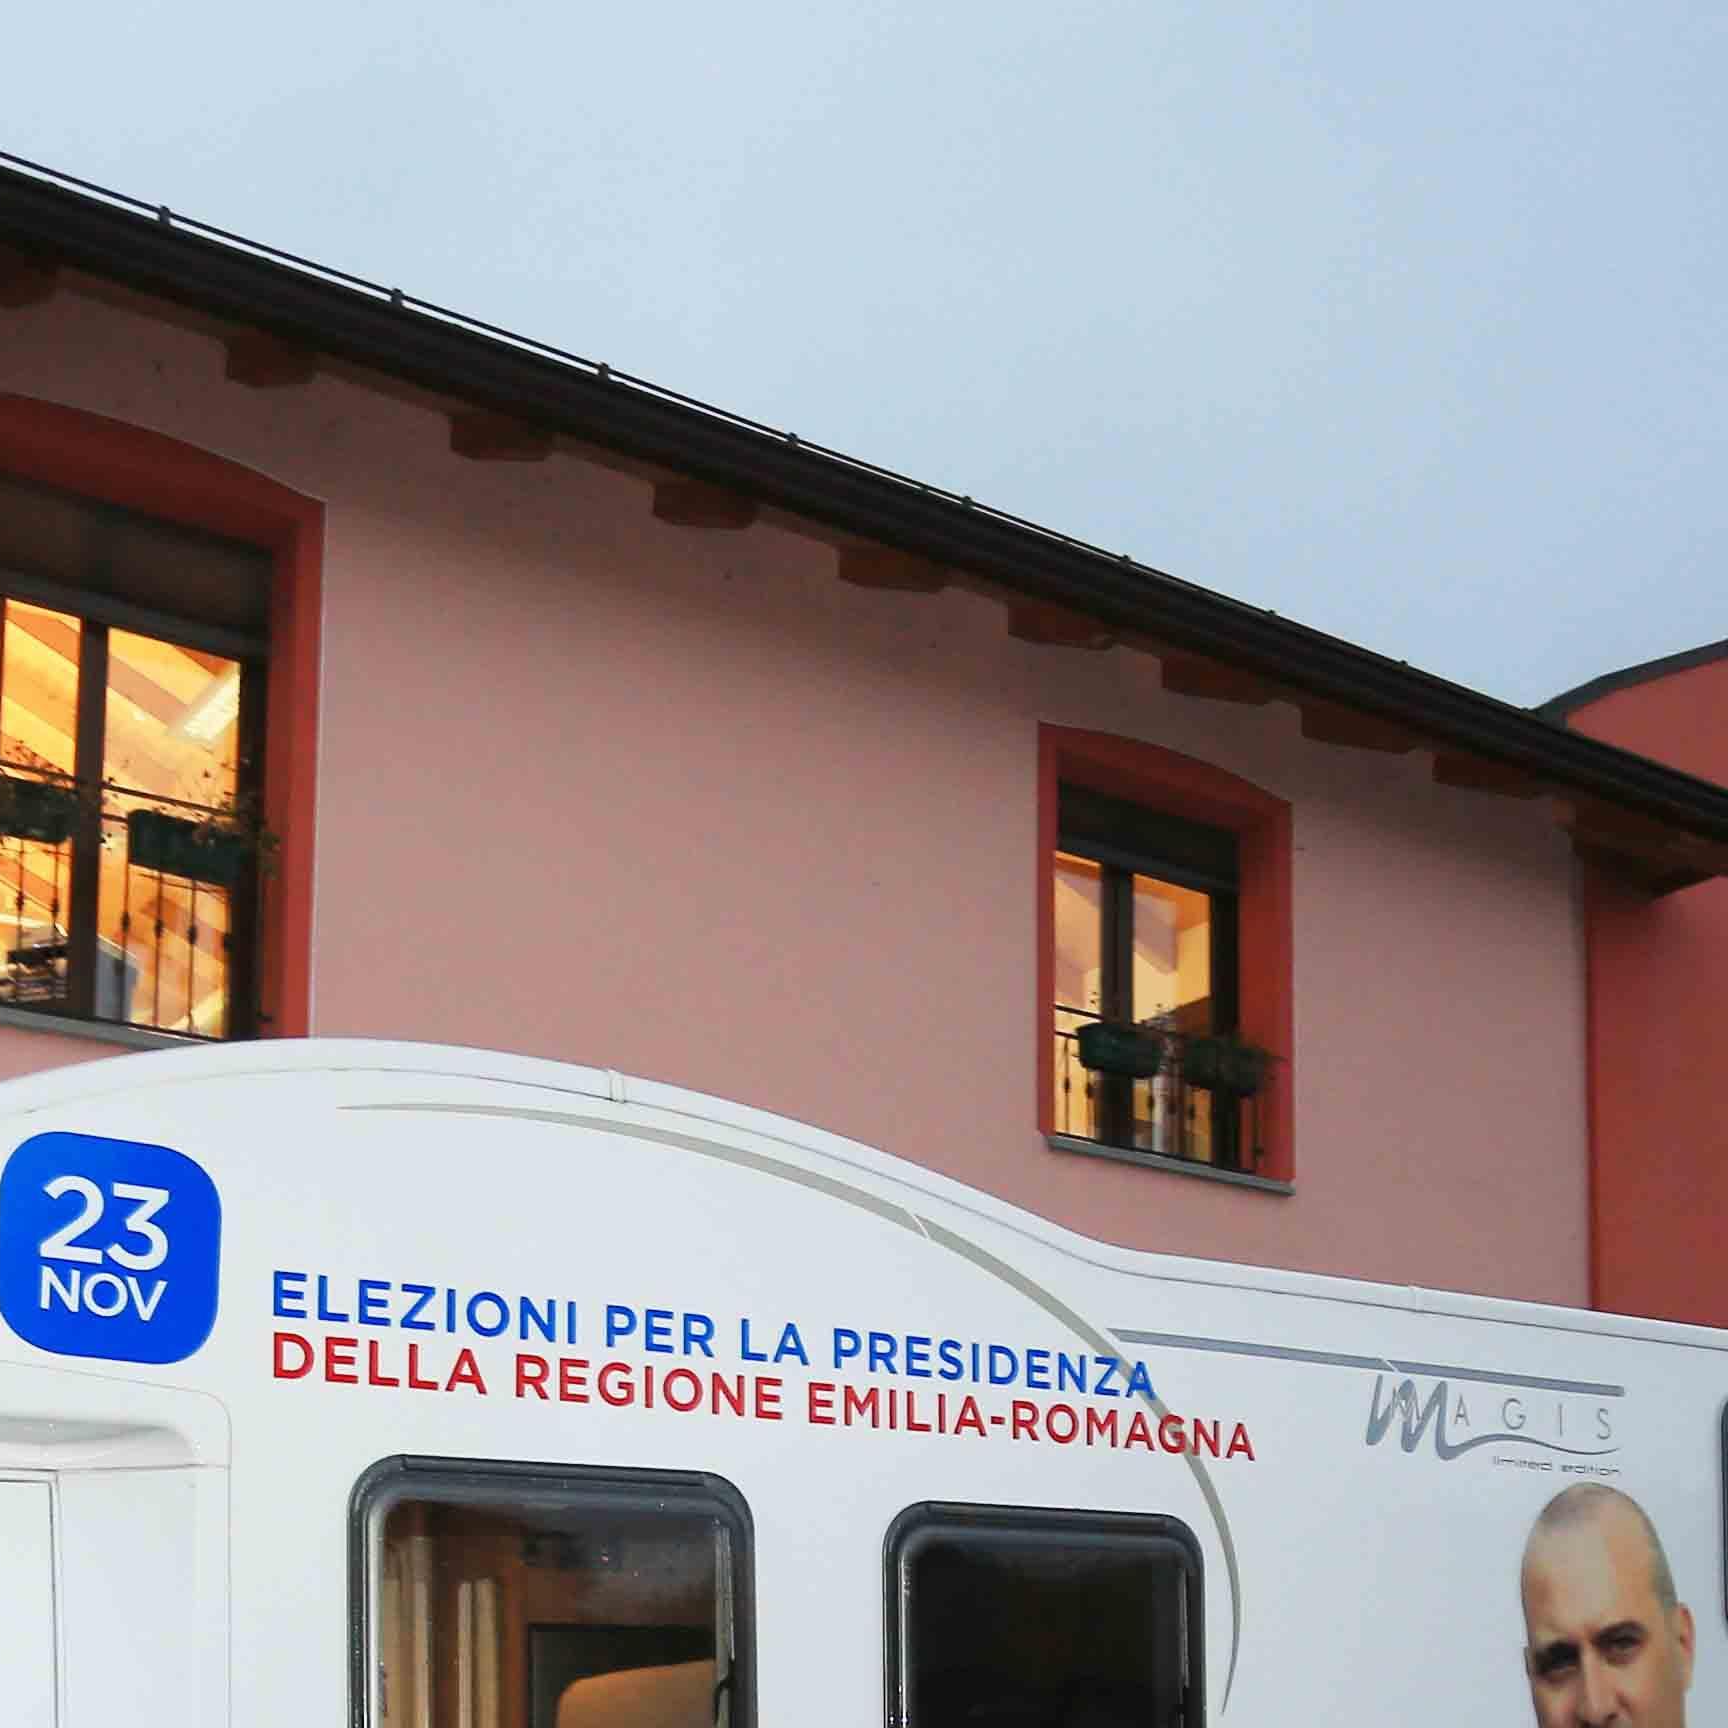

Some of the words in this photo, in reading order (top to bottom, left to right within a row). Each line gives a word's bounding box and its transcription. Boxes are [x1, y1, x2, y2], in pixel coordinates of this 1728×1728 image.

[38, 1174, 170, 1272] 23
[38, 1265, 169, 1324] NOV
[272, 1271, 577, 1344] ELEZIONI
[604, 1305, 715, 1358] PER
[739, 1317, 810, 1366] LA
[833, 1326, 1156, 1398] PRESIDENZA
[274, 1332, 487, 1395] DELLA
[514, 1355, 784, 1421] REGIONE
[808, 1383, 1257, 1461] EMILIA-ROMAGNA
